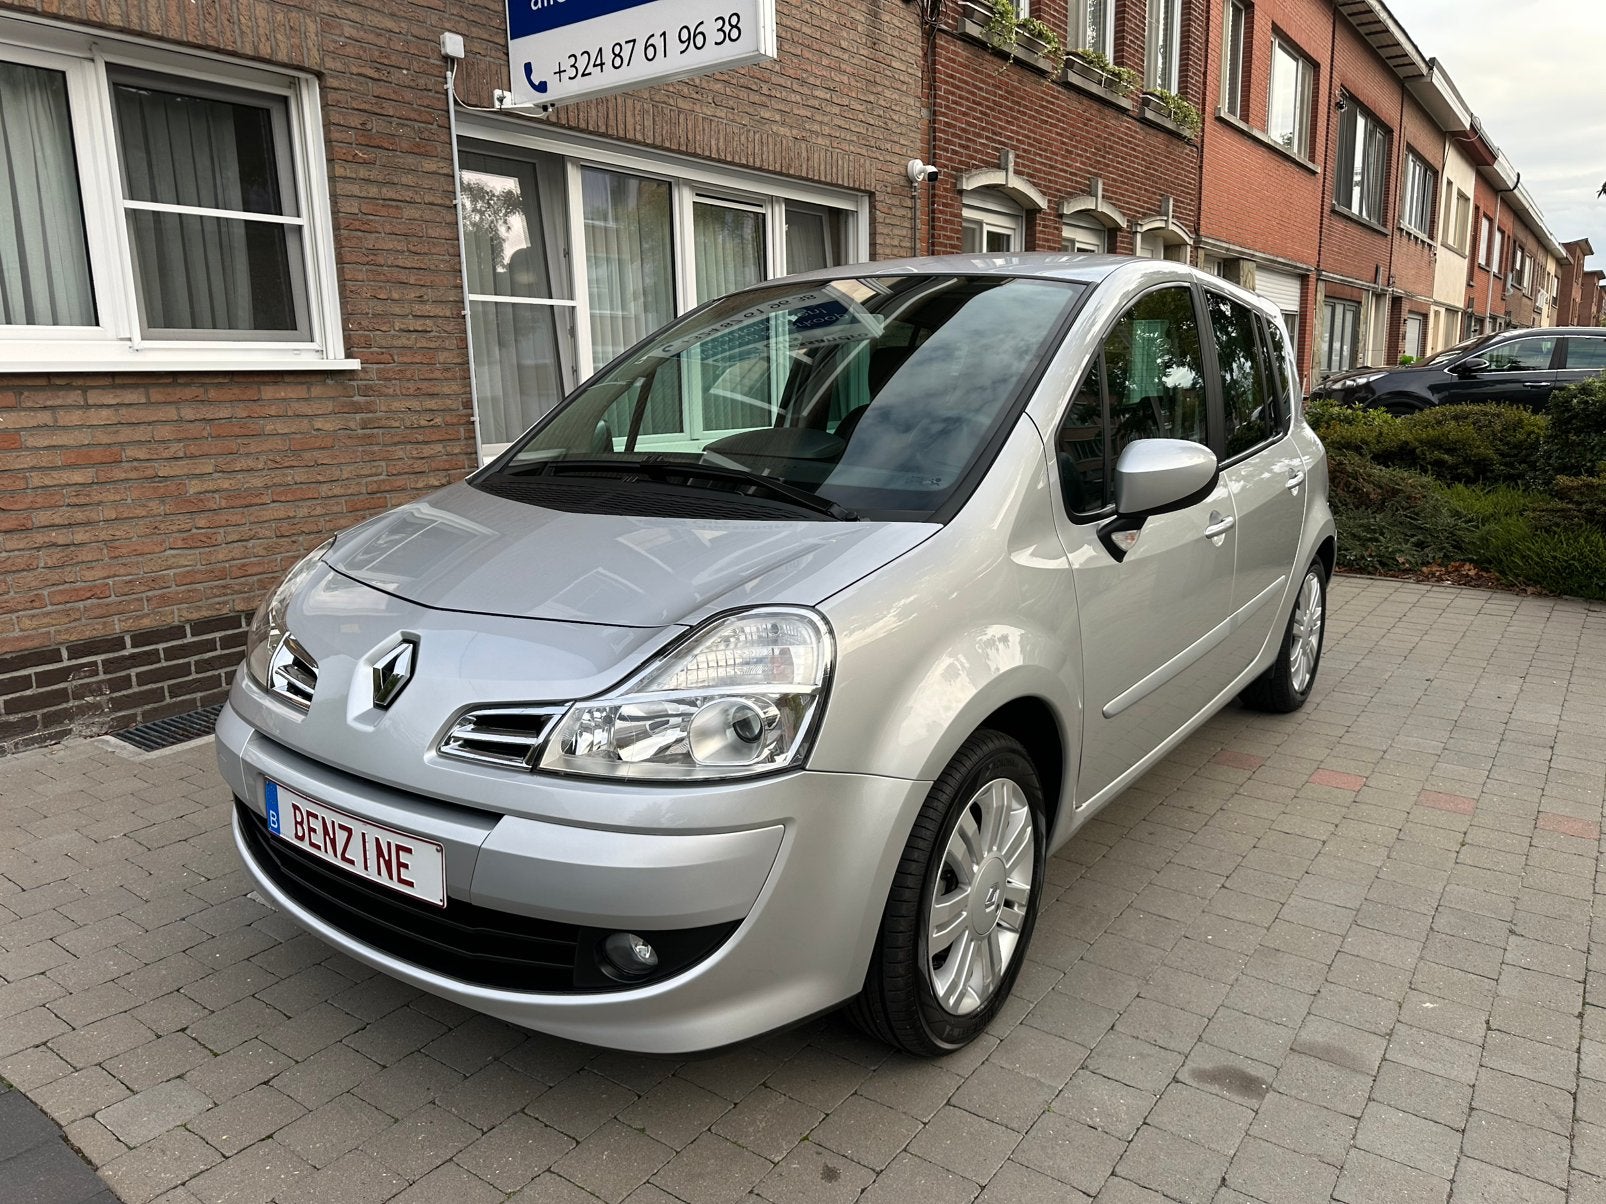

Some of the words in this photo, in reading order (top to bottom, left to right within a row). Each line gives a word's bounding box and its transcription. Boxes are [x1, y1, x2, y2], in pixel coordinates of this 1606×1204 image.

[553, 47, 606, 82] +324
[611, 38, 637, 70] 87
[643, 31, 668, 62] 61
[678, 21, 707, 54] 96
[714, 12, 742, 46] 38
[269, 810, 278, 829] B
[291, 801, 415, 888] BENZINE
